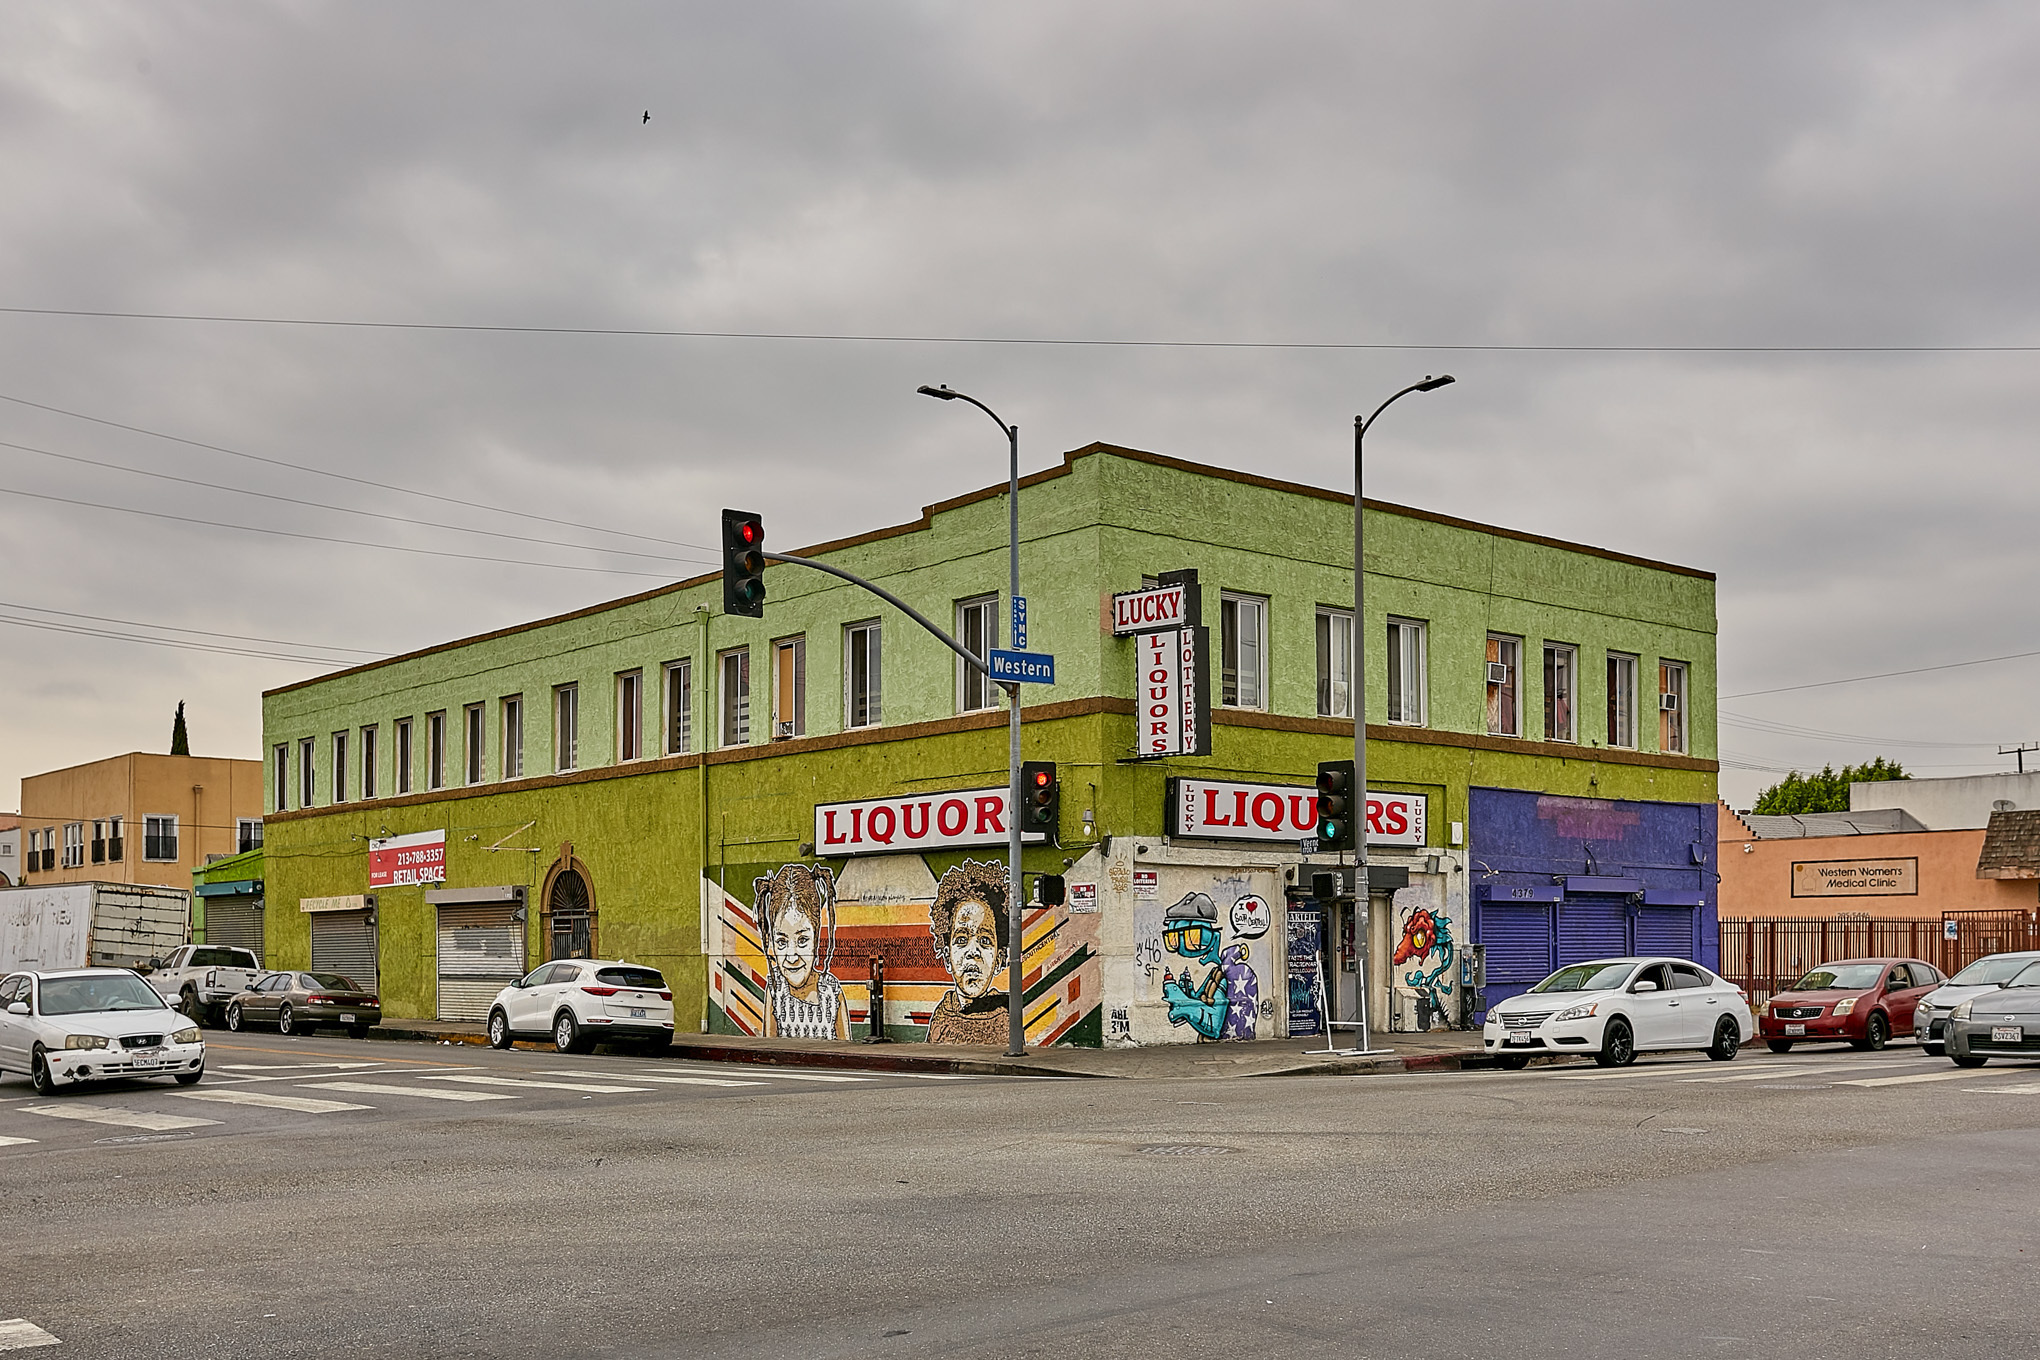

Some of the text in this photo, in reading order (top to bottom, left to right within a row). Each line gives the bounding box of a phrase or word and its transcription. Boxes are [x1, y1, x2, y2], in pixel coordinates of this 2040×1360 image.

[1018, 600, 1026, 646] SYNC
[1118, 591, 1181, 626] LUCKY
[994, 656, 1051, 678] Western
[1149, 635, 1168, 752] LIQUORS
[1182, 632, 1193, 750] LOTTERY
[824, 796, 1010, 845] LIQUOR
[1186, 784, 1194, 832] LUCKY
[1203, 788, 1409, 835] LIQURS
[393, 866, 444, 884] RETAIL SPACE
[1818, 867, 1903, 877] Western Women's
[1826, 878, 1897, 888] Medical Clinic
[305, 898, 341, 910] RECYCLE ME
[1512, 888, 1534, 898] 4379
[1145, 938, 1161, 963] 46
